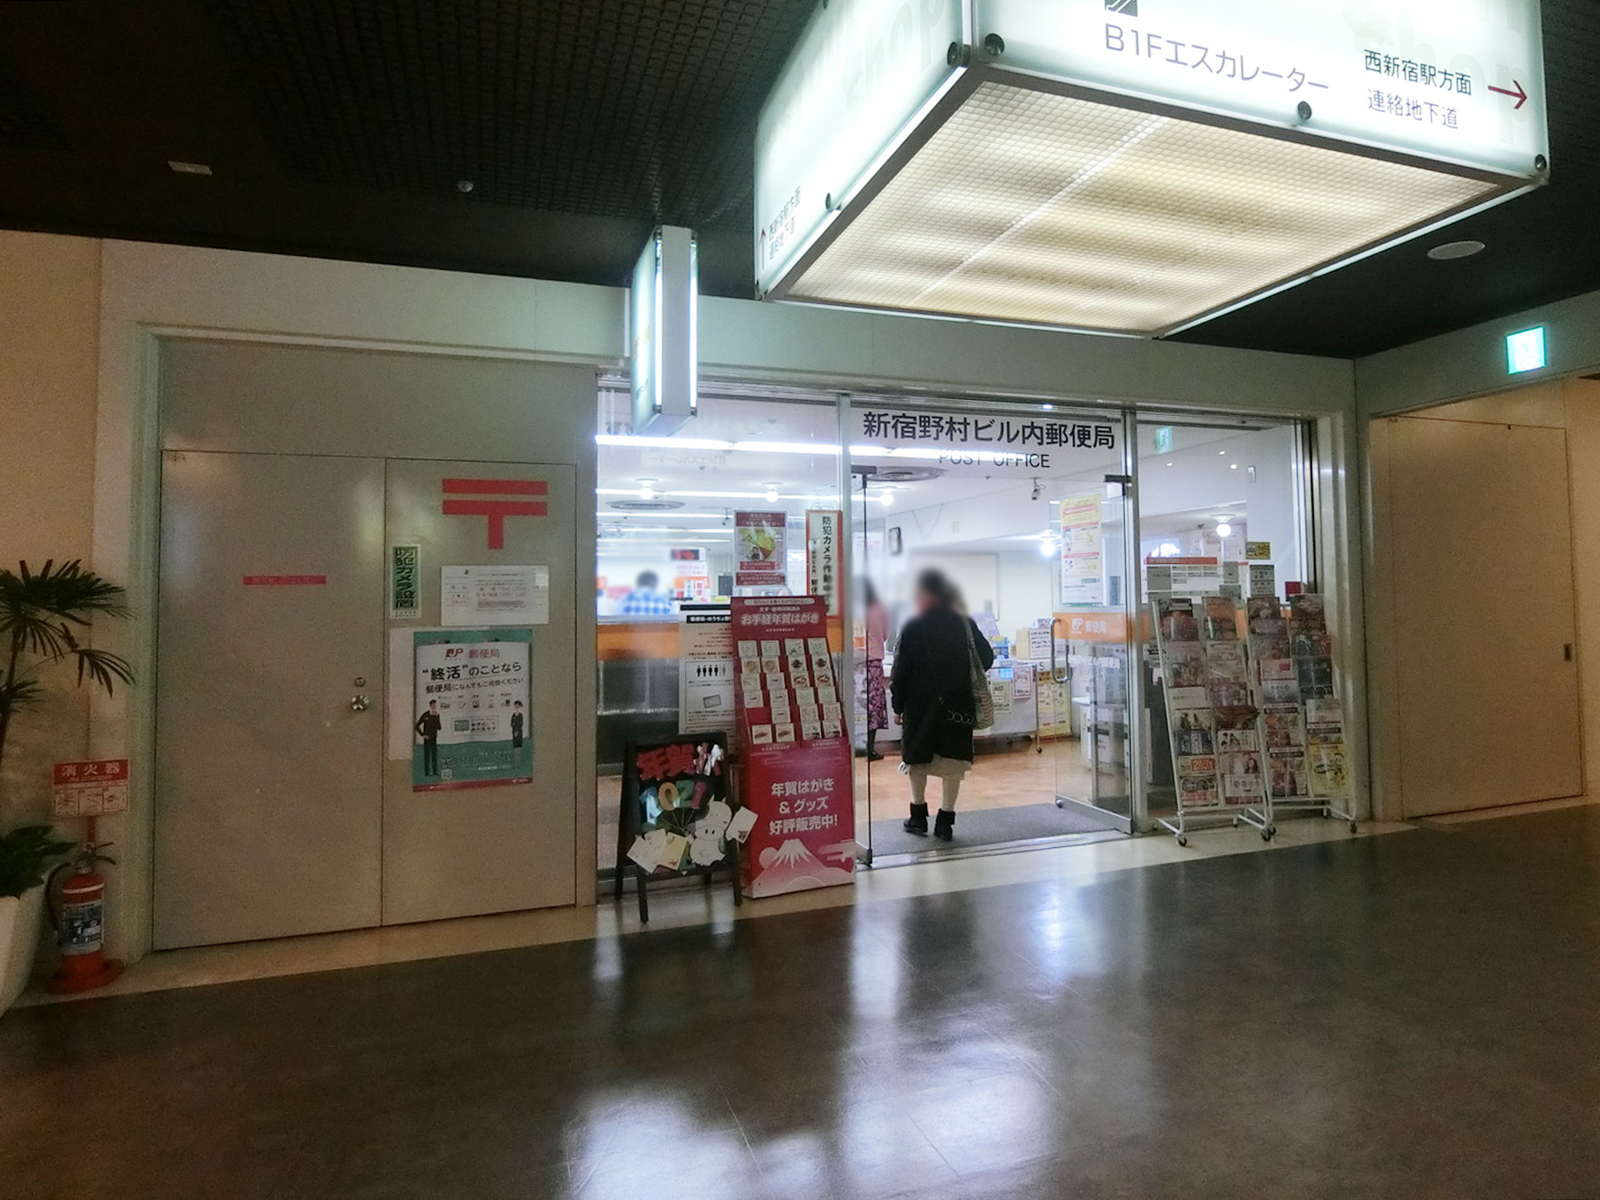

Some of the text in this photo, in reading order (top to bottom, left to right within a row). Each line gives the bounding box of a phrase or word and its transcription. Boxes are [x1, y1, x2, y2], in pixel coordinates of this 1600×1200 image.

[1105, 23, 1329, 92] B1Fエスカレーター
[1363, 49, 1472, 96] 西新宿駅方面
[1367, 88, 1459, 130] 連絡地下道
[863, 411, 1115, 449] 新宿野村ビル内郵便局
[469, 649, 501, 659] 郵便局
[61, 761, 120, 777] 消火器
[771, 778, 834, 797] 年賀はがき
